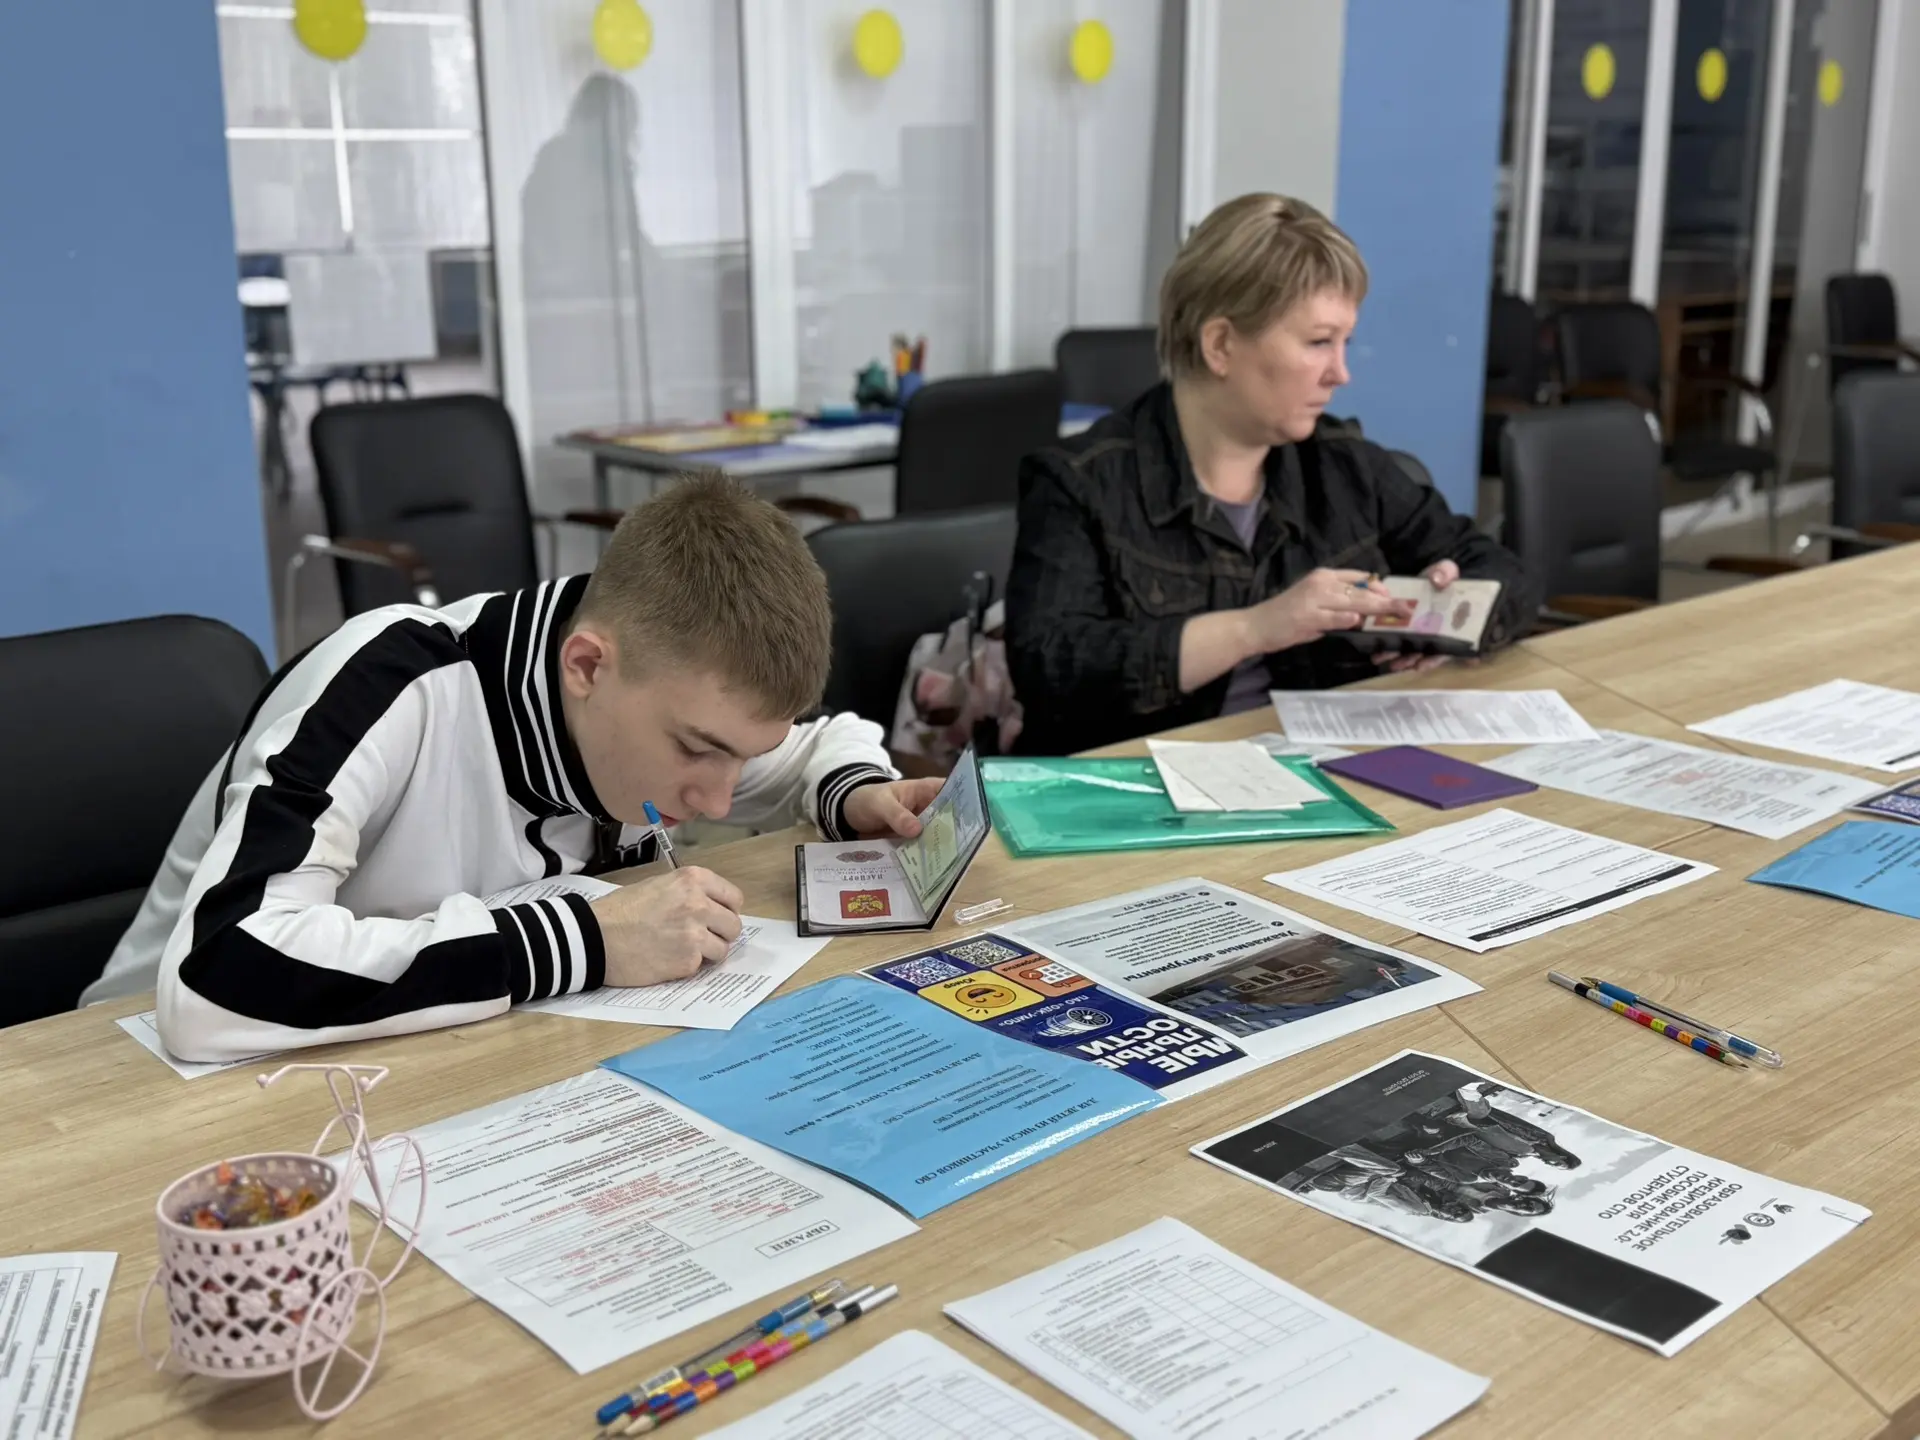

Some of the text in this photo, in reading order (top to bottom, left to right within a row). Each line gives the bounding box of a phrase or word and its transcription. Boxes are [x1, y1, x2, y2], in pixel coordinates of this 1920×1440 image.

[1216, 929, 1297, 955] Уважаемые
[943, 976, 975, 990] Юмор
[1122, 951, 1215, 982] абитуриенты
[1062, 993, 1089, 1005] ПАО
[1077, 1014, 1186, 1057] ОСТИ
[1090, 1025, 1212, 1072] ЛЬНЫЕ
[914, 1097, 1097, 1185] ДЛЯ ДЕТЕЙ ИЗ ЧИСЛА УЧАСТНИКОВ СВО
[1595, 1163, 1691, 1221] СТУДЕНТОВ СПО
[1612, 1175, 1725, 1245] КРЕДИТОВАНИЕ 2.0:
[1623, 1169, 1708, 1220] ПОСОБИЕ ДЛЯ
[770, 1222, 829, 1253] ОБРАЗЕЦ
[1630, 1180, 1744, 1253] ОБРАЗОВАТЕЛЬНОЕ
